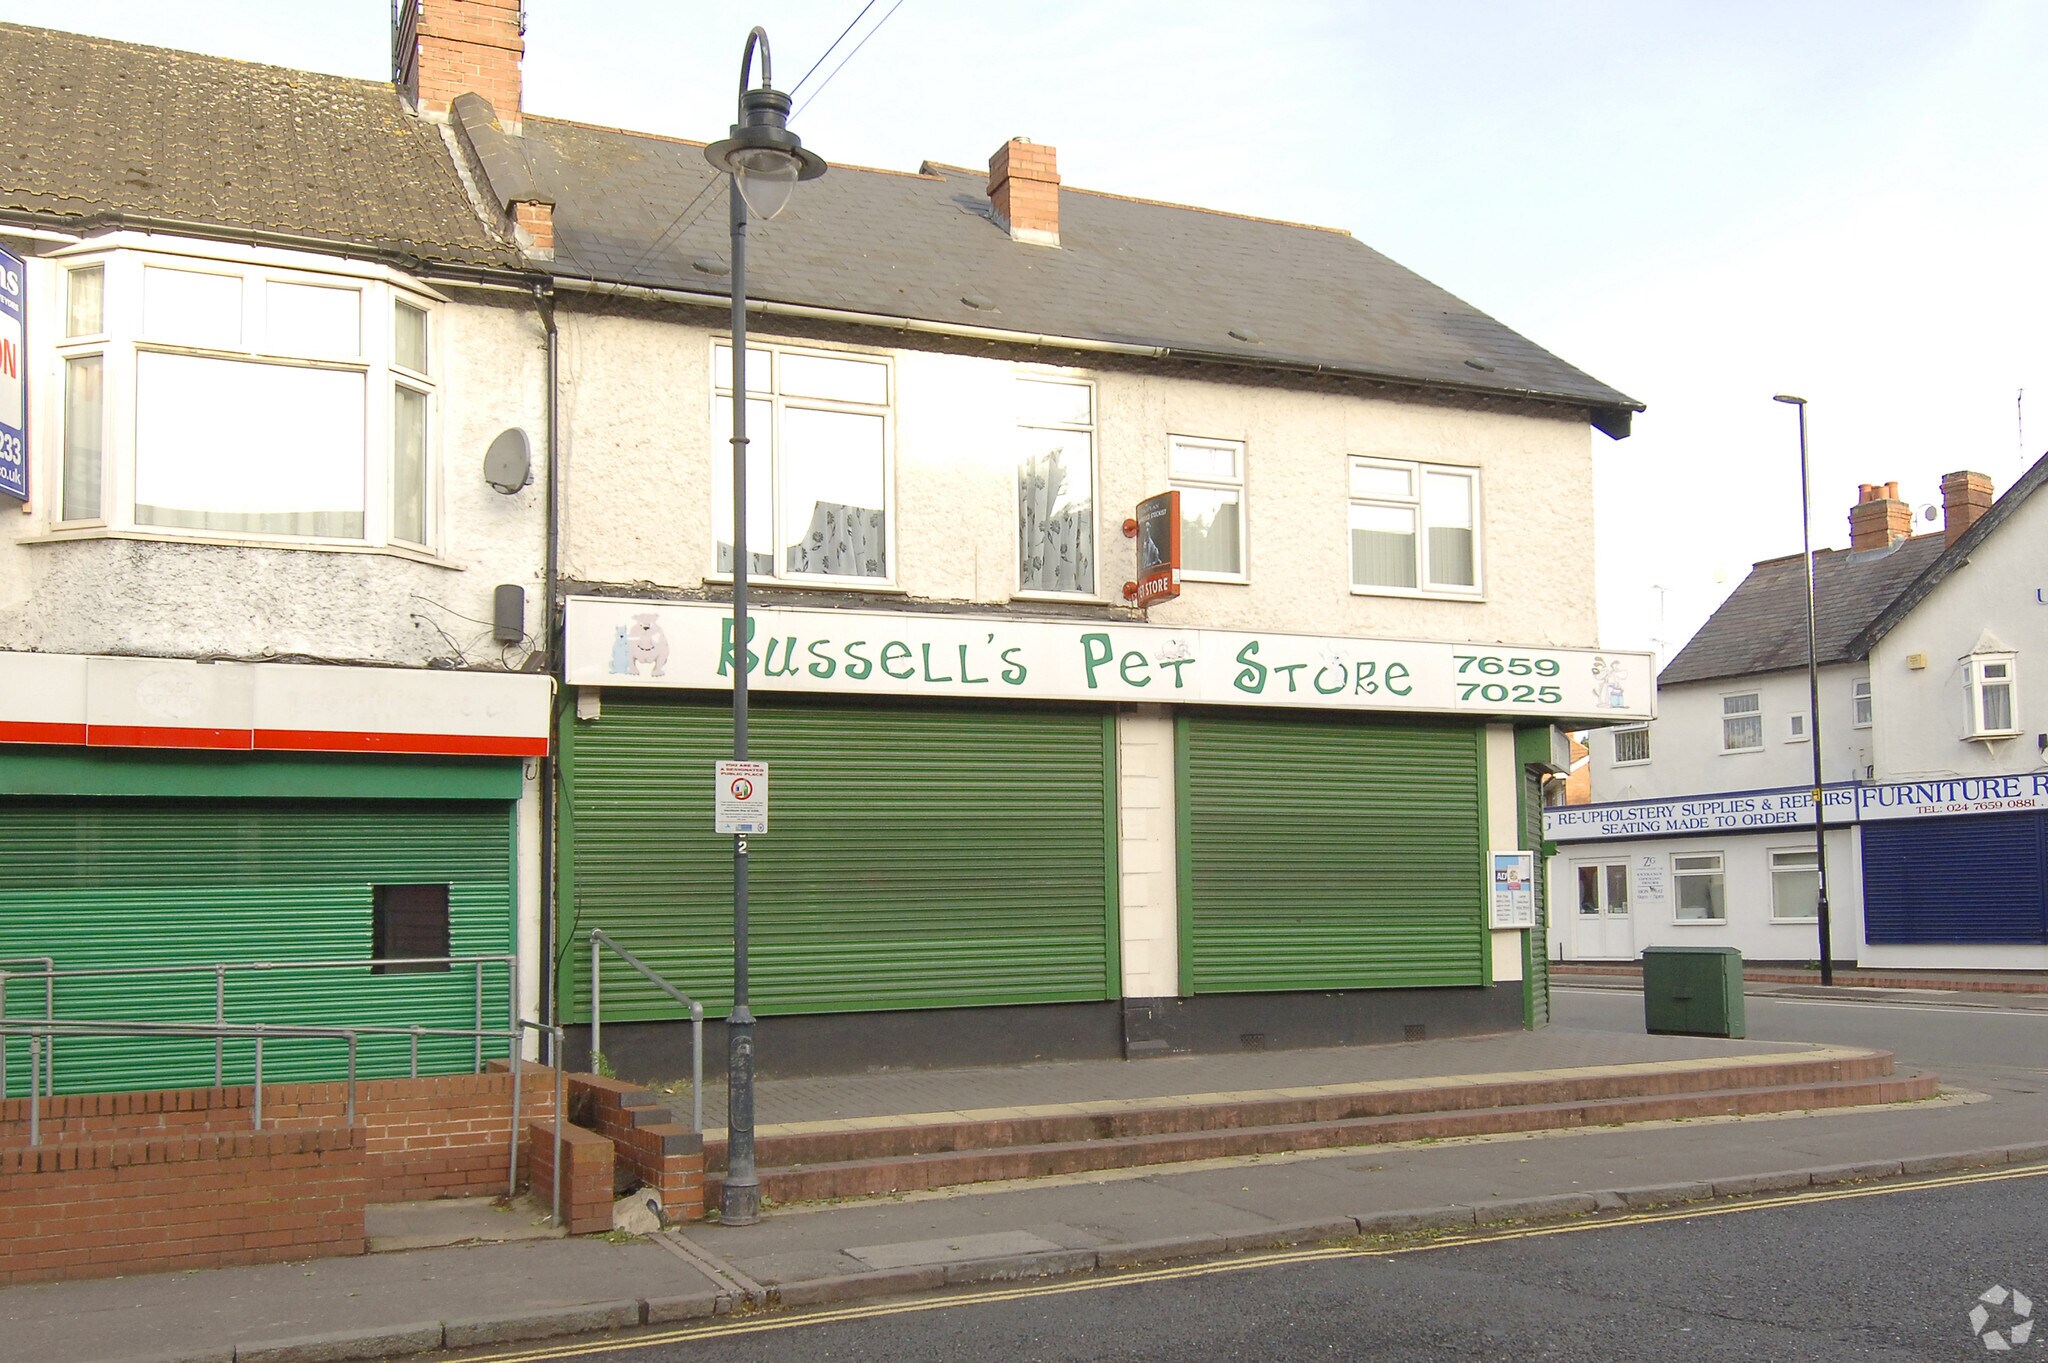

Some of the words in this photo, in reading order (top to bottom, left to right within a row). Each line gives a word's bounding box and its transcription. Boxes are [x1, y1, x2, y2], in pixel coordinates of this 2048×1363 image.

[1145, 577, 1168, 596] STORE
[1453, 655, 1560, 677] 7659
[1456, 683, 1563, 704] 7025
[1862, 776, 2022, 808] FURNITURE
[1558, 805, 1675, 826] RE-UPHOLSTERY
[1681, 798, 1755, 817] SUPPLIES
[1761, 798, 1773, 811] &
[1780, 791, 1852, 809] REPIRS
[1916, 805, 1942, 814] TEL:
[1946, 803, 1969, 812] 024
[1973, 801, 2003, 811] 7659
[2007, 799, 2035, 808] 0881
[1601, 821, 1660, 836] SEATING
[1666, 816, 1710, 831] MADE
[1715, 815, 1737, 827] TO
[1742, 811, 1798, 826] ORDER
[738, 841, 747, 854] 2
